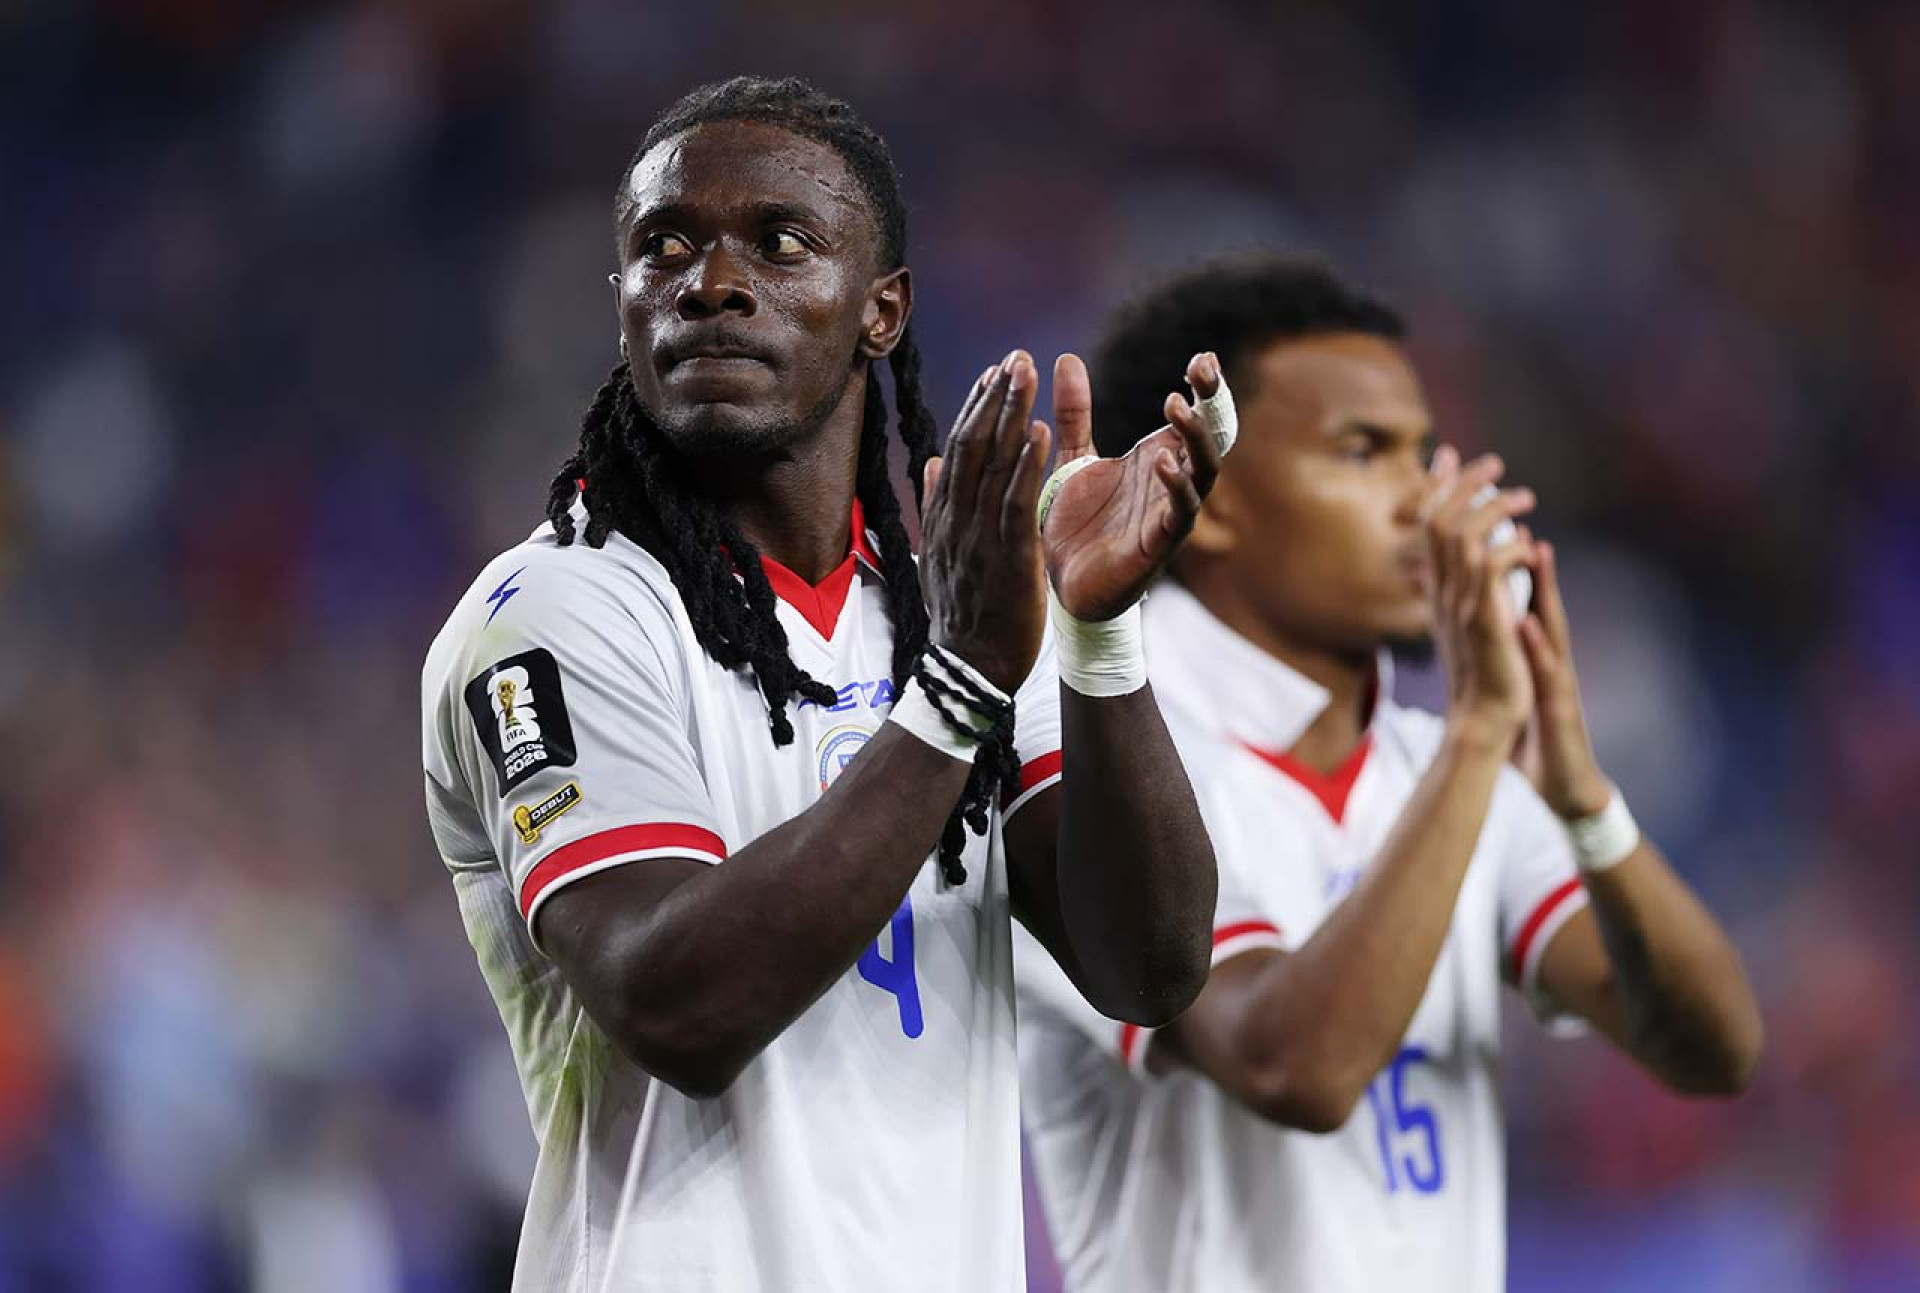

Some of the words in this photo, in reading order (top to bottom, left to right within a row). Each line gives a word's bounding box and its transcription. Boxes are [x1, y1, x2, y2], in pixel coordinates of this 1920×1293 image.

[506, 730, 527, 743] FIFA
[506, 750, 549, 780] 2026
[531, 787, 573, 820] DEBUT
[1366, 1045, 1444, 1194] 15
